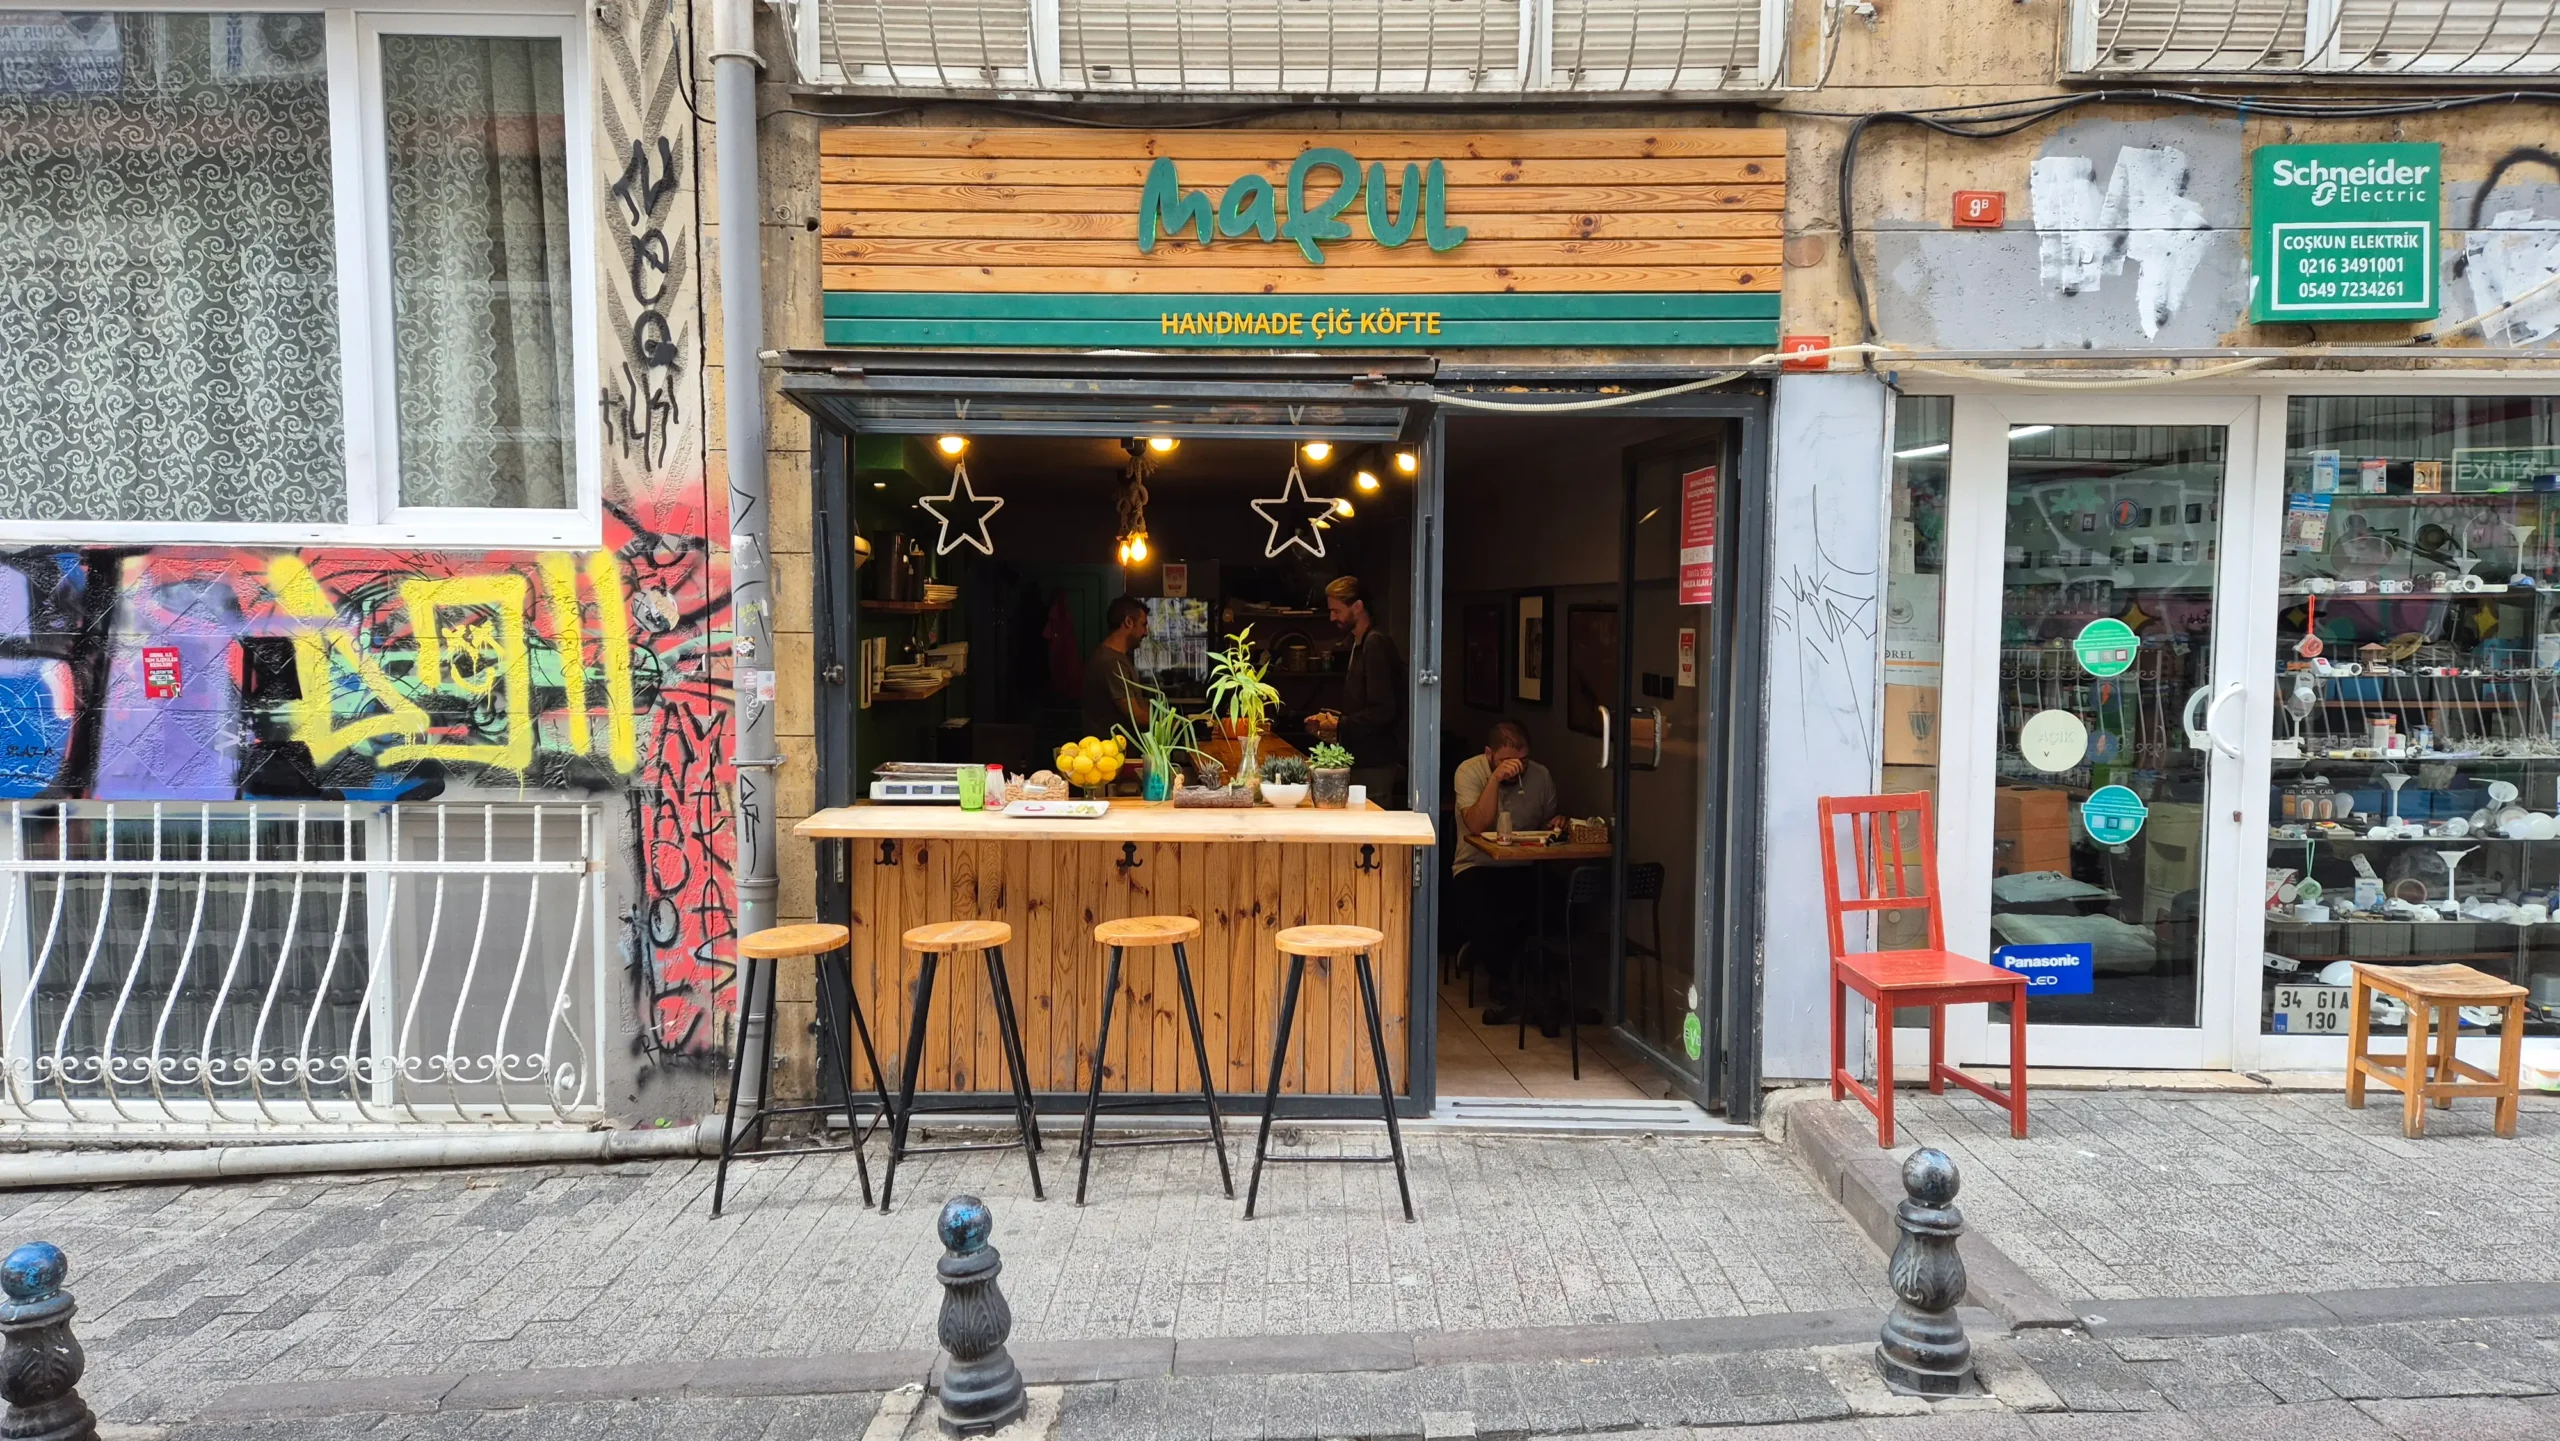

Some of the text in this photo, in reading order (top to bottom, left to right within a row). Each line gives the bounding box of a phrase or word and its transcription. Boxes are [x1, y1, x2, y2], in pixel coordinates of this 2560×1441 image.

[2273, 159, 2431, 187] Schneider
[2340, 187, 2426, 203] Electric
[2283, 232, 2419, 253] COŞKUN ELEKTRİK
[2299, 257, 2404, 273] 0216 3491001
[2299, 281, 2404, 297] 0549 7234261
[1161, 308, 1441, 340] HANDMADE ÇİĞ KÖFTE
[2458, 463, 2510, 480] EXIT
[2038, 731, 2075, 745] AÇIK
[2003, 953, 2080, 968] Panasonic
[2280, 990, 2349, 1009] 34 GIA
[2306, 1012, 2337, 1030] 130
